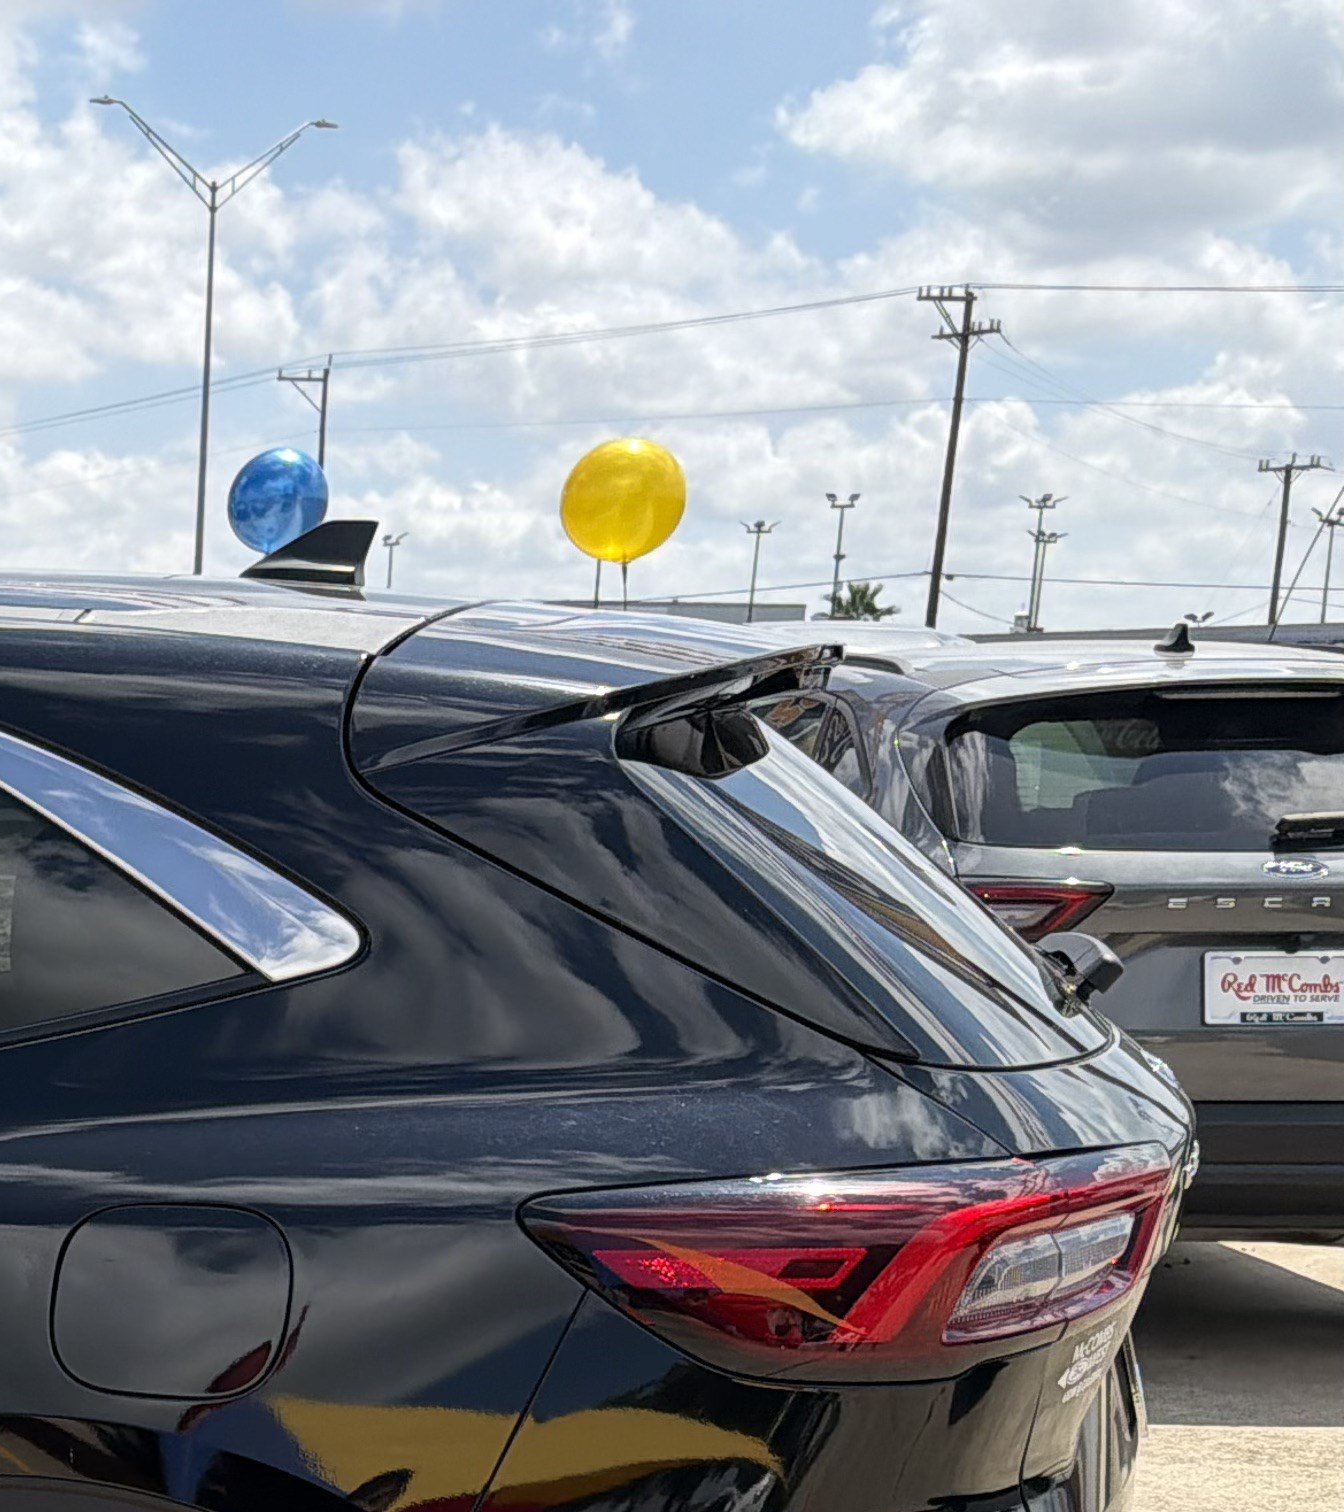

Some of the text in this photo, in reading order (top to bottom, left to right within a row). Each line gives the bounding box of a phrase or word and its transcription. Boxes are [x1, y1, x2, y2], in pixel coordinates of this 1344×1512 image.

[1220, 972, 1341, 1001] Red McCombs
[1252, 994, 1341, 1003] DRIVEN TO SERVE
